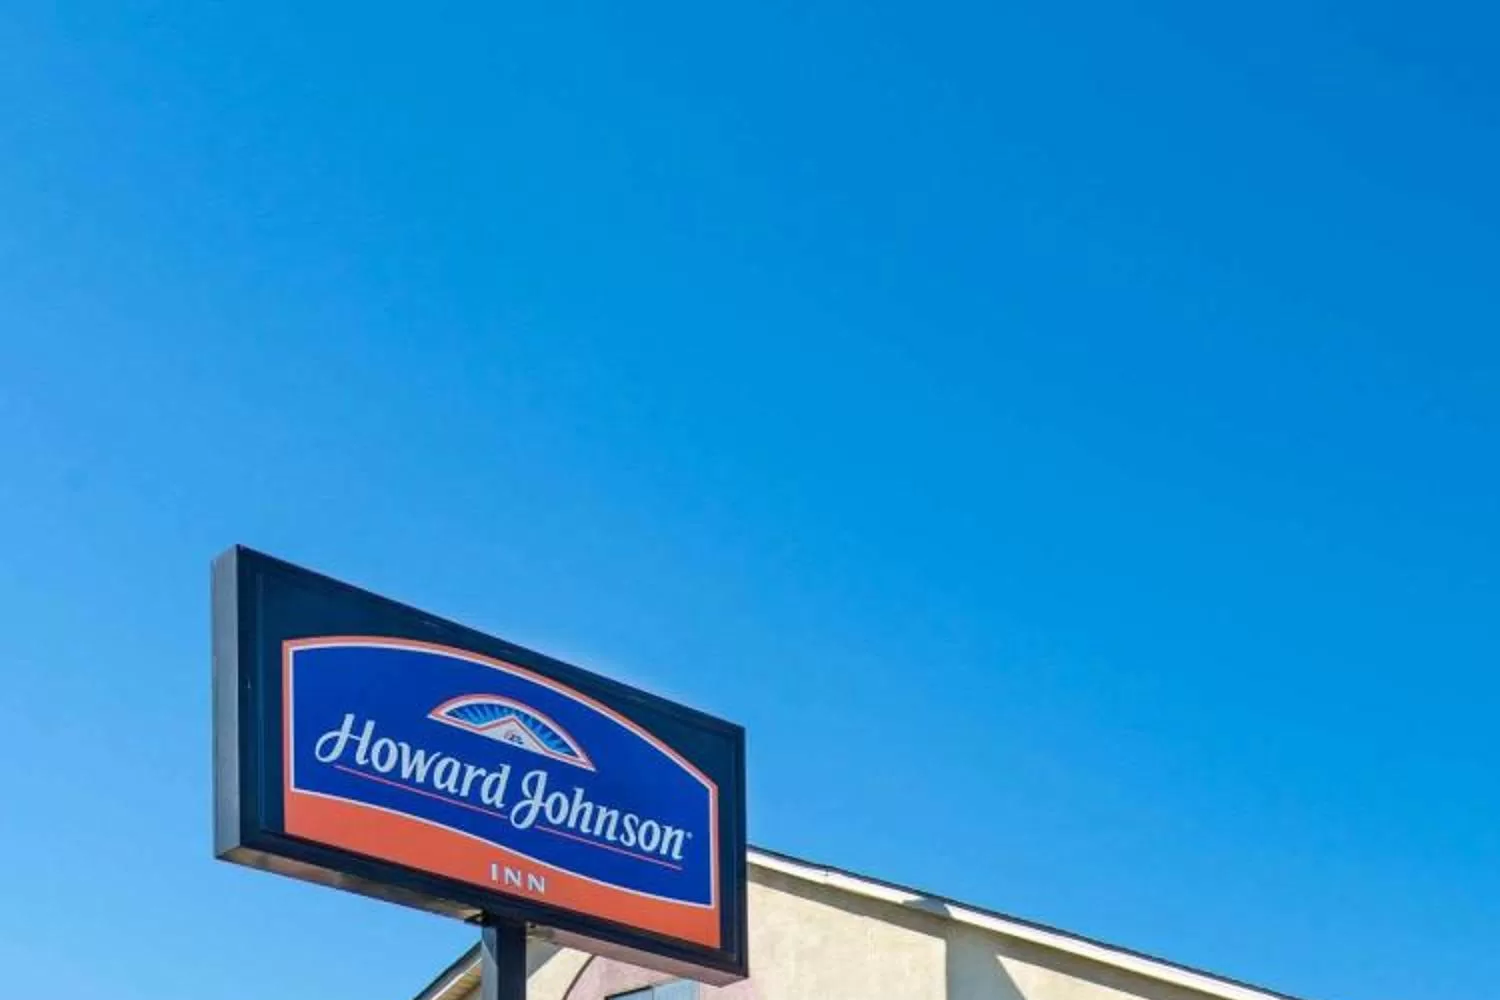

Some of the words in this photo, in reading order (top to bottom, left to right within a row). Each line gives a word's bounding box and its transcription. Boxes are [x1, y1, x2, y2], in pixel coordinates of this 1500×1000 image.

[315, 713, 511, 808] Howard
[510, 770, 683, 860] Johnson
[491, 863, 545, 896] INN
